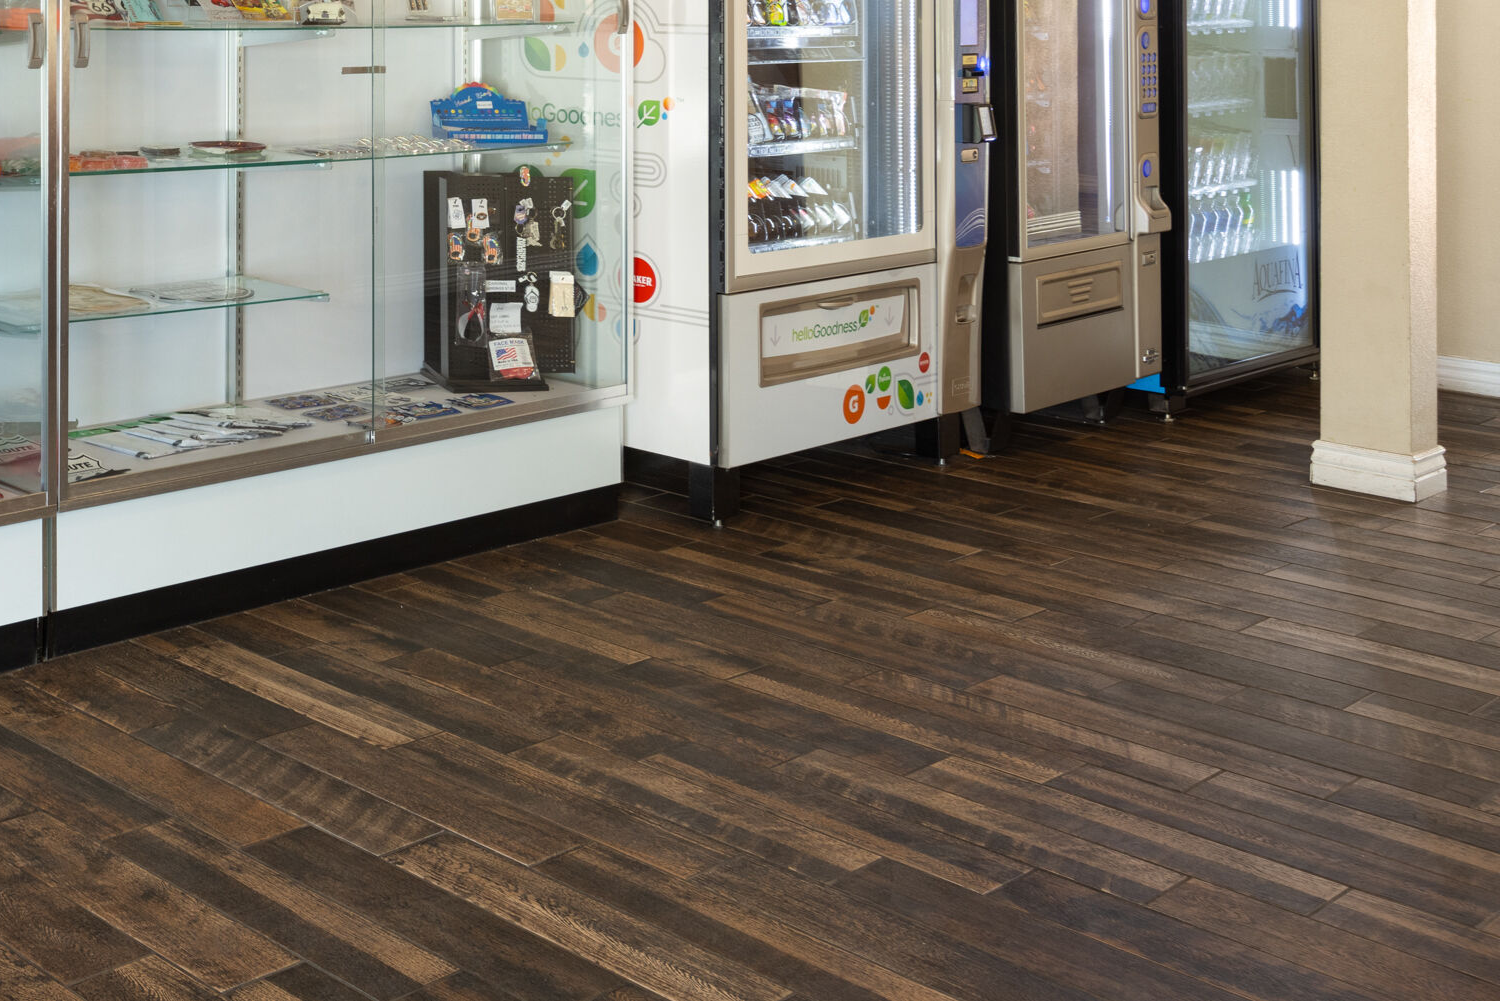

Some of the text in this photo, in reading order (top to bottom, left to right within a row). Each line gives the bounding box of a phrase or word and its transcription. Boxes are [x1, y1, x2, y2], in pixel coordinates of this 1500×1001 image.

[92, 2, 111, 13] 66
[633, 275, 653, 287] AKER
[1252, 250, 1302, 300] AQUAFINA
[792, 320, 858, 343] helloGoodness
[849, 395, 859, 413] G
[68, 461, 93, 471] UTE
